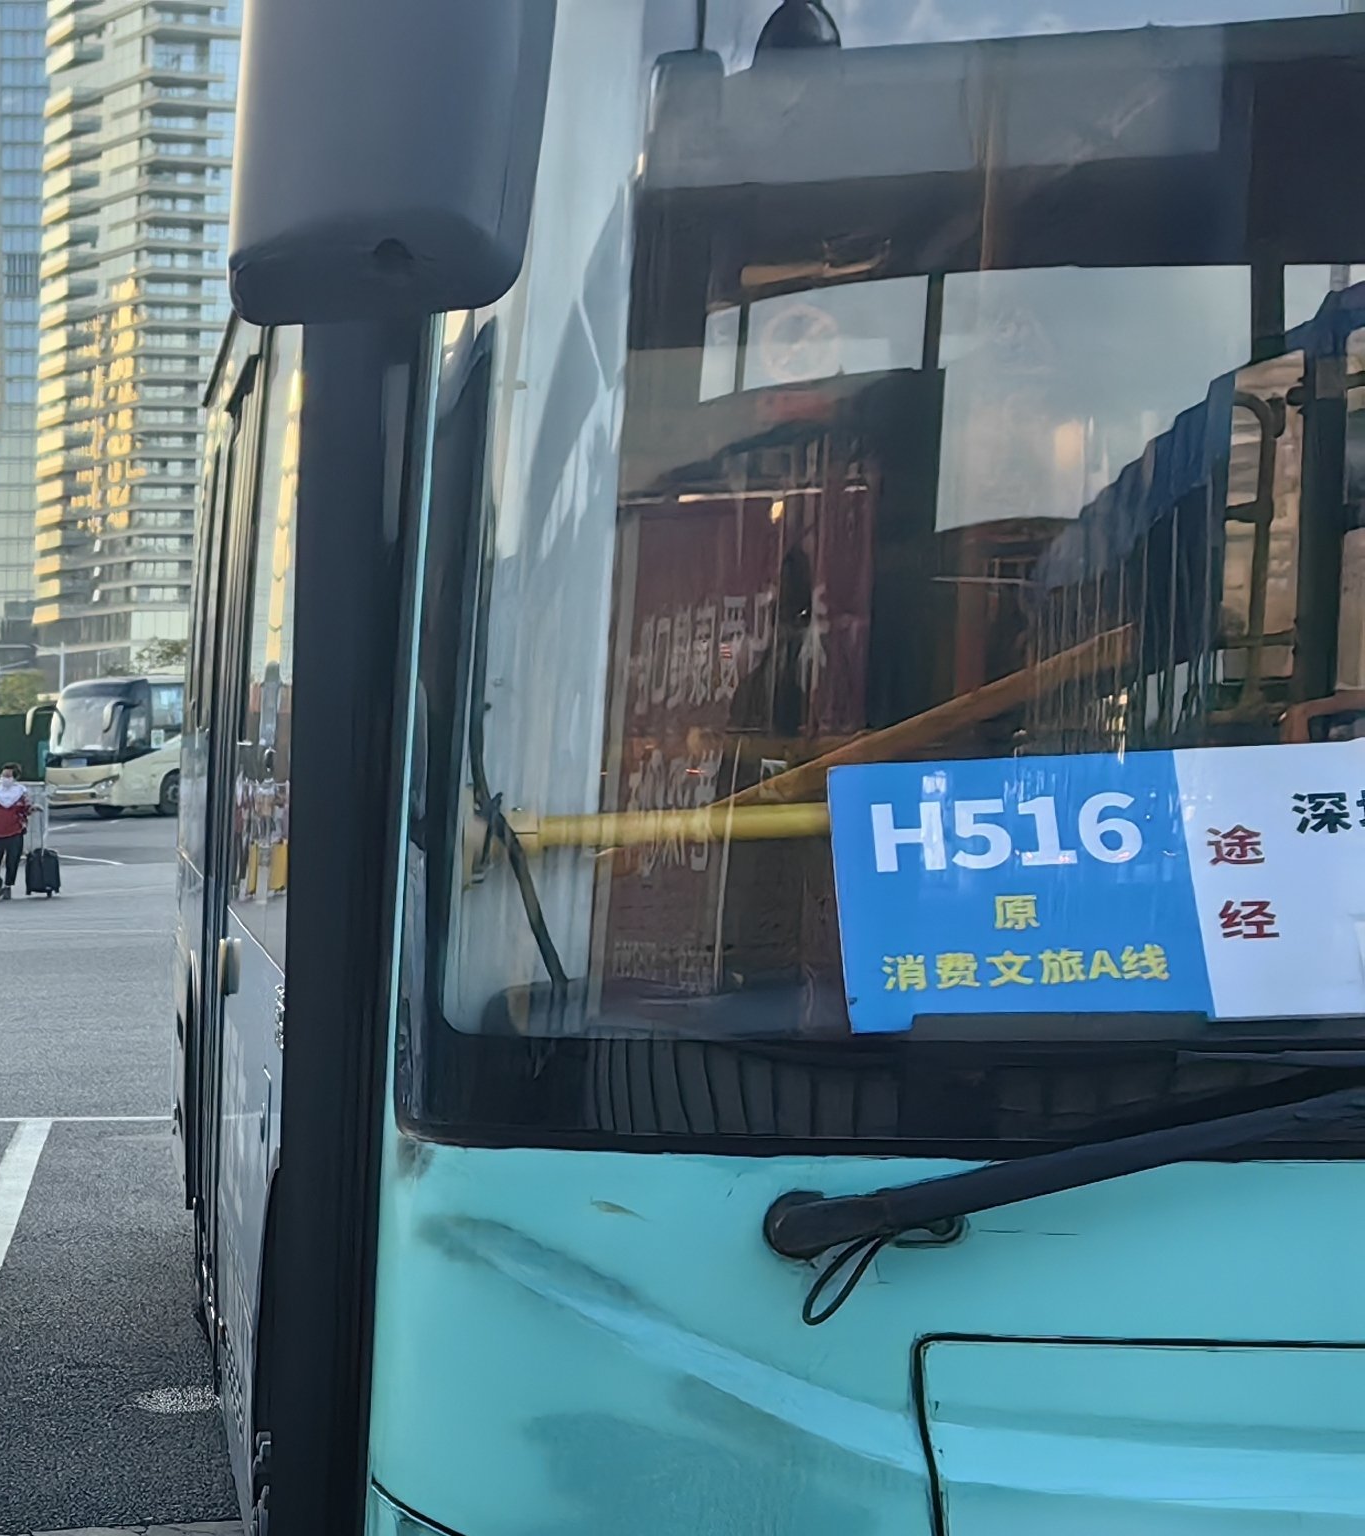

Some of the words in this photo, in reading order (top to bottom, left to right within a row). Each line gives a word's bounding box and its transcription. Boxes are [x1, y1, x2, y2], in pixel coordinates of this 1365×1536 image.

[870, 791, 1143, 873] H516
[1291, 789, 1365, 834] 深
[994, 894, 1040, 930] 原
[882, 944, 1170, 992] 消费文旅A线
